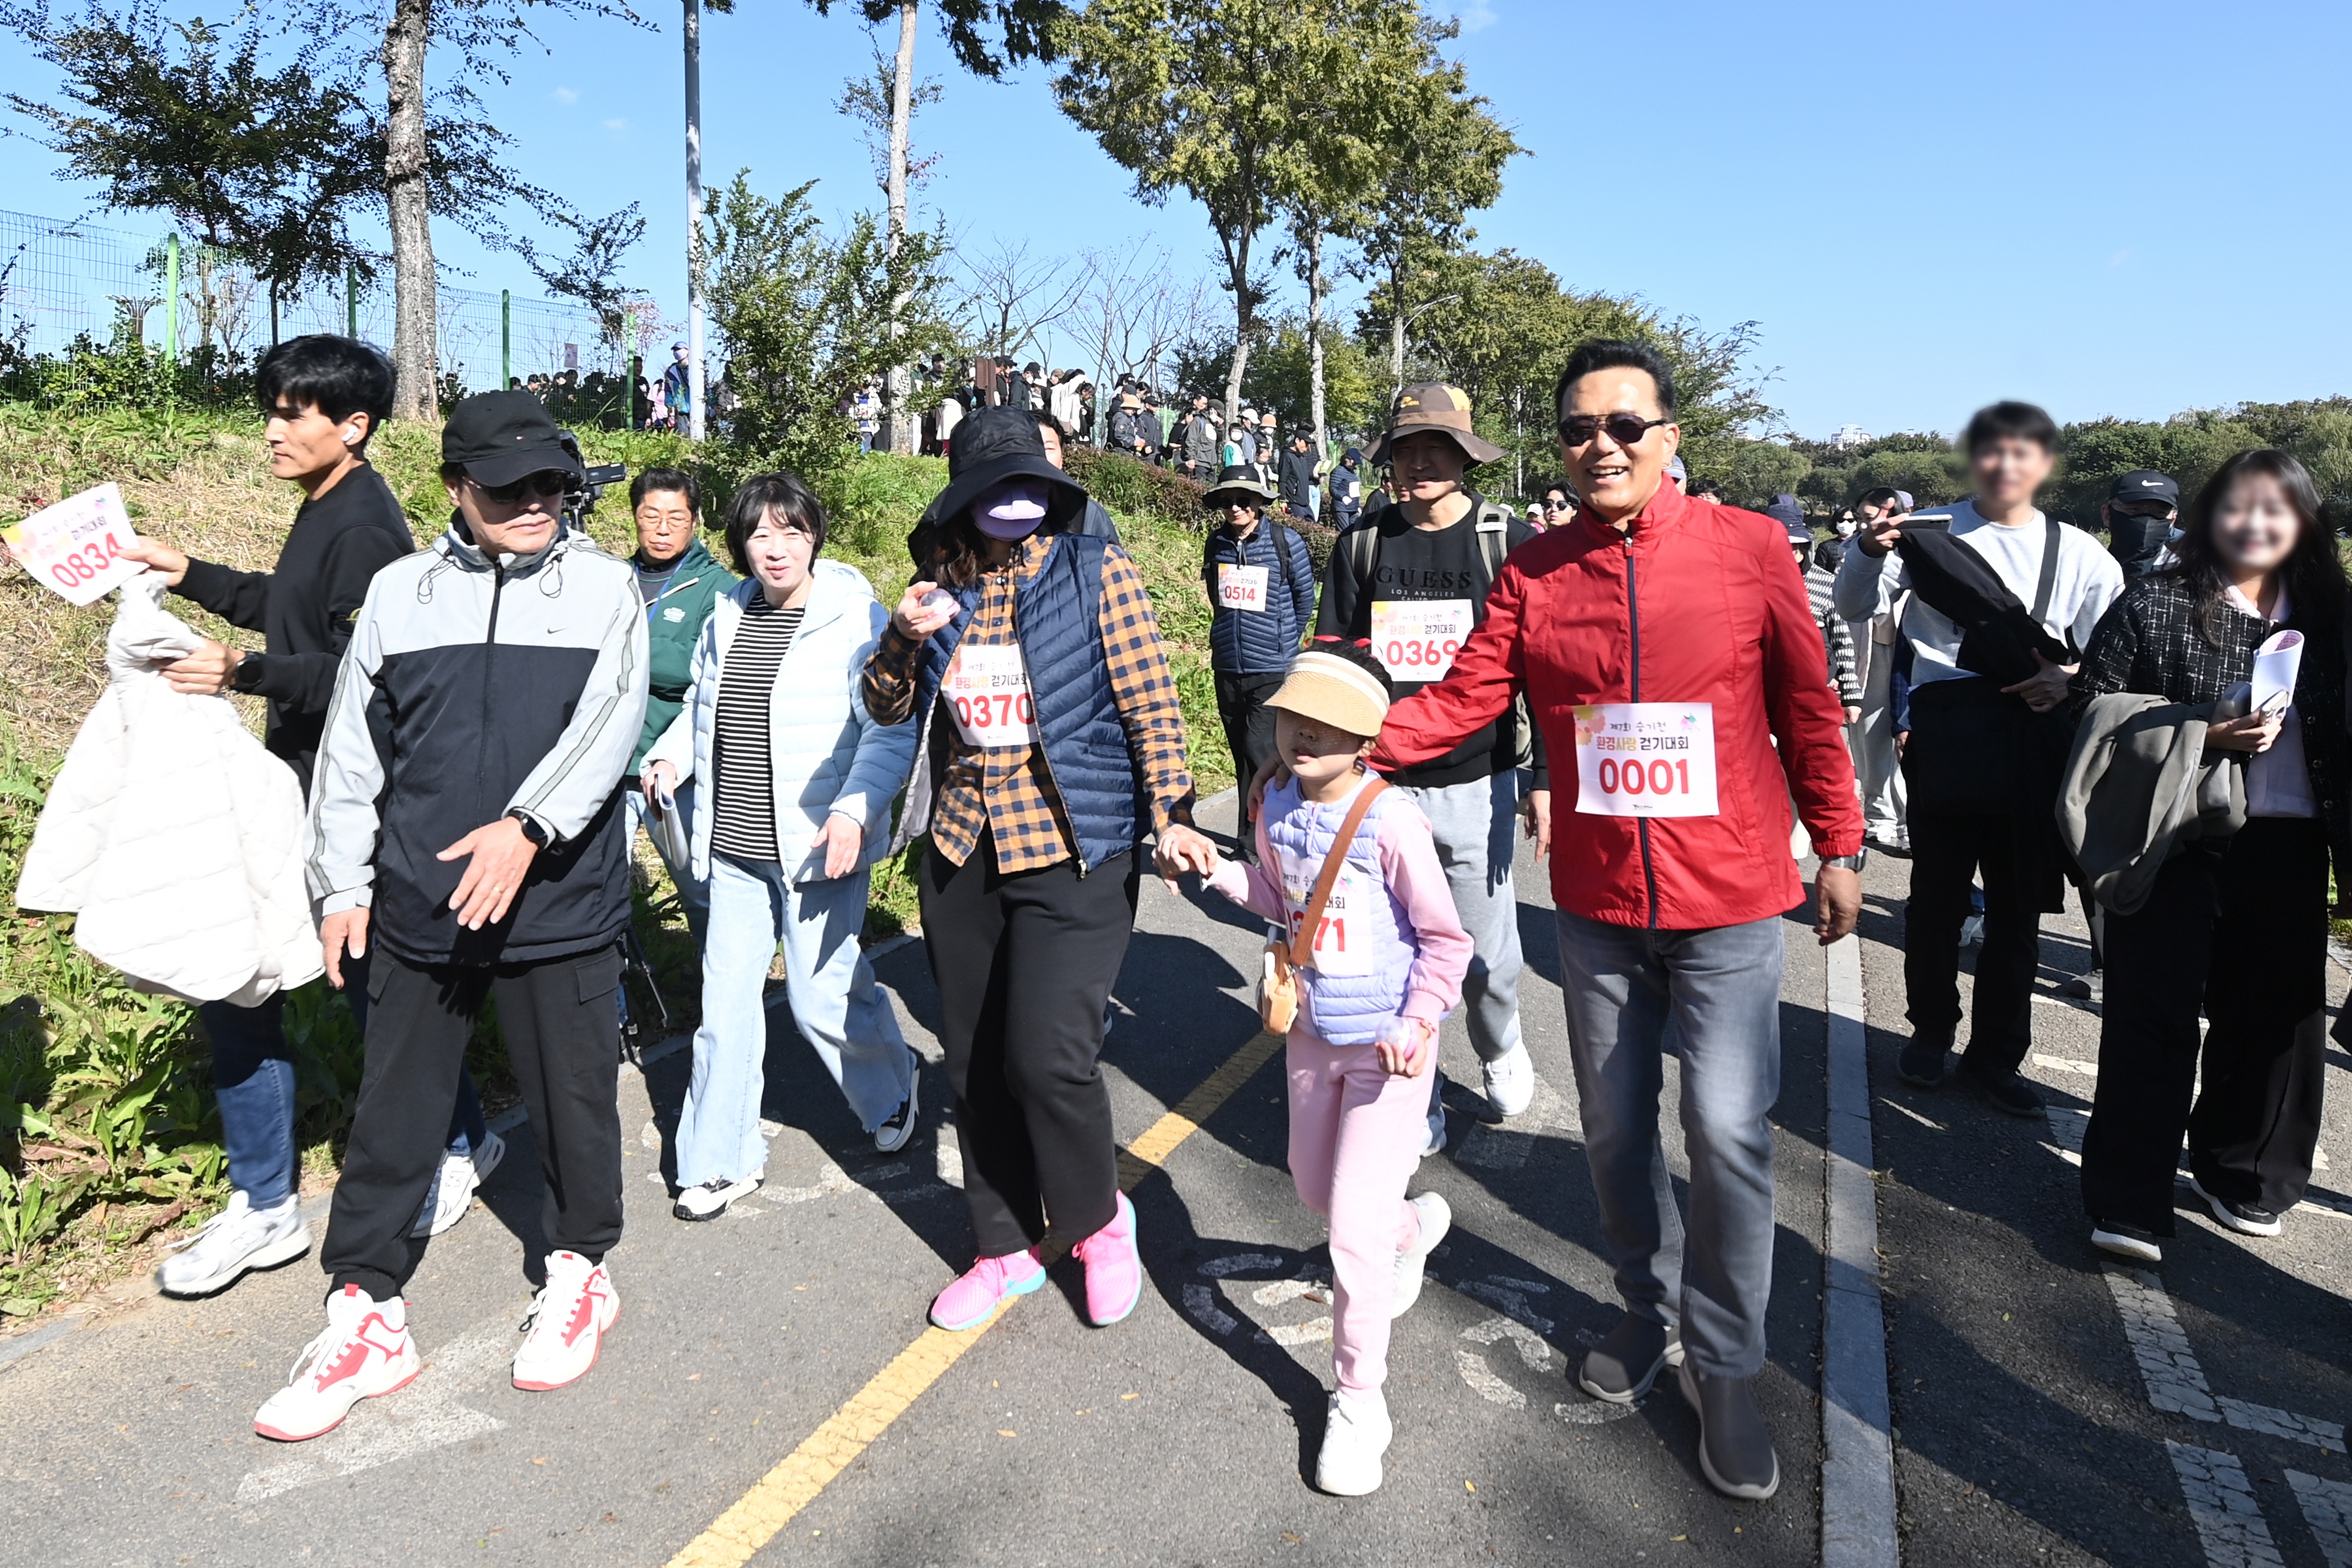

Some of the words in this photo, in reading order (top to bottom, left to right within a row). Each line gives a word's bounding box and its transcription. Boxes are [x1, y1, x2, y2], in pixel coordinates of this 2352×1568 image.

[52, 532, 122, 588] 0834
[1375, 566, 1472, 590] GUESS
[1225, 585, 1256, 602] 0514
[1390, 588, 1409, 596] LOS
[1414, 590, 1455, 598] ANGELES
[1425, 623, 1456, 635] 걷기대회
[1386, 640, 1460, 666] 0369
[955, 676, 989, 689] 환경사랑
[955, 693, 1036, 728] 0370
[1610, 722, 1631, 732] 제7회
[1635, 721, 1666, 732] 승기천
[1596, 736, 1637, 751] 환경사랑
[1639, 736, 1689, 751] 걷기대회
[1599, 758, 1689, 795] 0001
